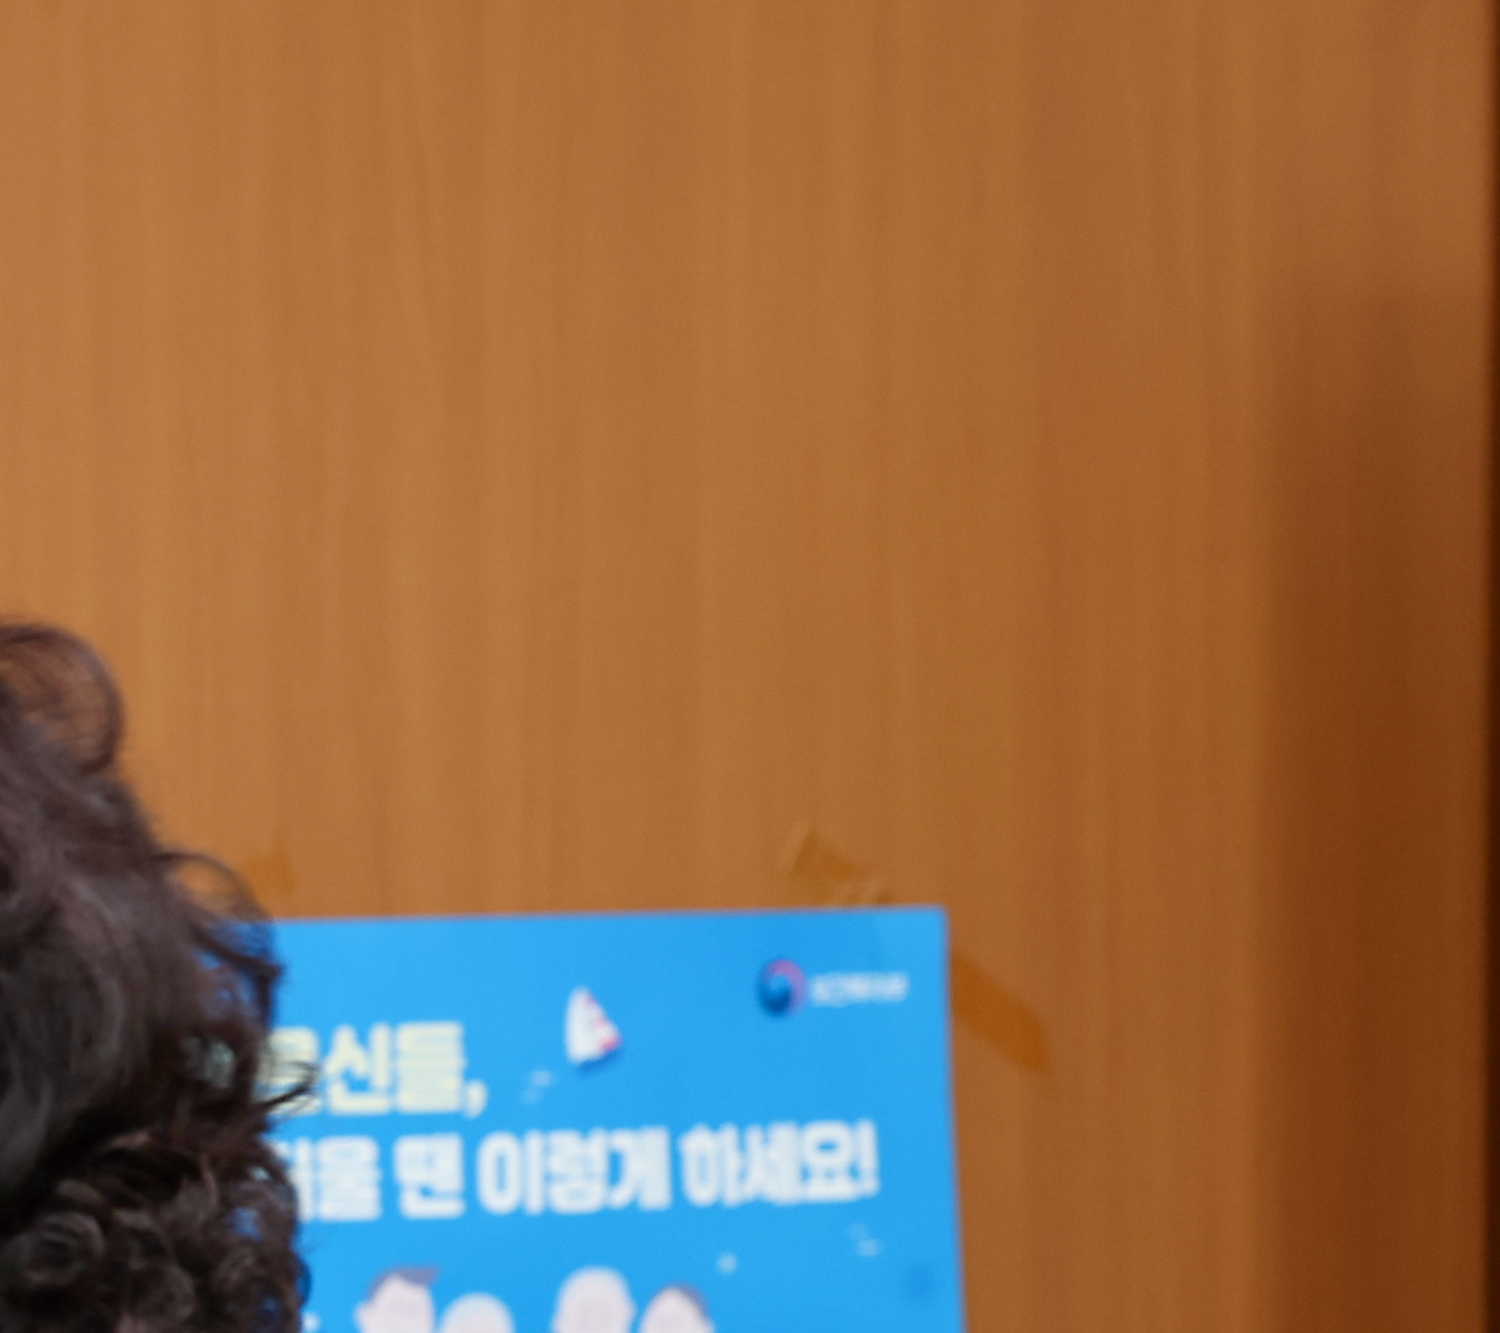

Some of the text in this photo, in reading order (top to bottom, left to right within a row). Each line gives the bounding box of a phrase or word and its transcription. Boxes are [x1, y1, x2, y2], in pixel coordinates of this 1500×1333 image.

[258, 1021, 488, 1118] 르신들,
[393, 1132, 466, 1220] 땐
[476, 1126, 671, 1216] 이렇게
[678, 1118, 881, 1208] 하세요!
